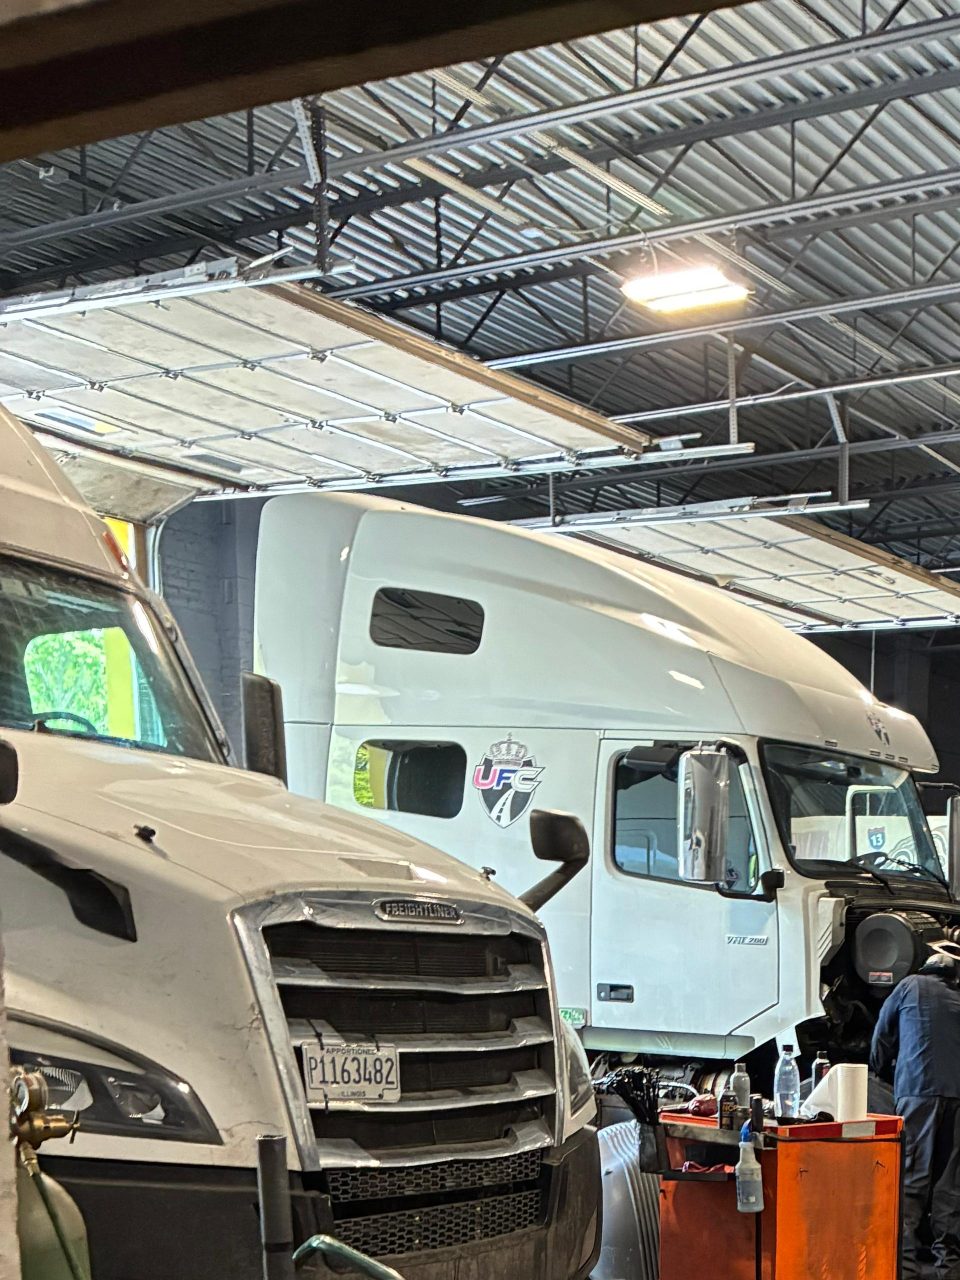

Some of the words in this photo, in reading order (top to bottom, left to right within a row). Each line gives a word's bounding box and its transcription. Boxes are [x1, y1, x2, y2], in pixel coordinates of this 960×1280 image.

[473, 765, 545, 792] UFC
[385, 903, 457, 918] FREIGHTLINER
[308, 1056, 395, 1085] P1163482
